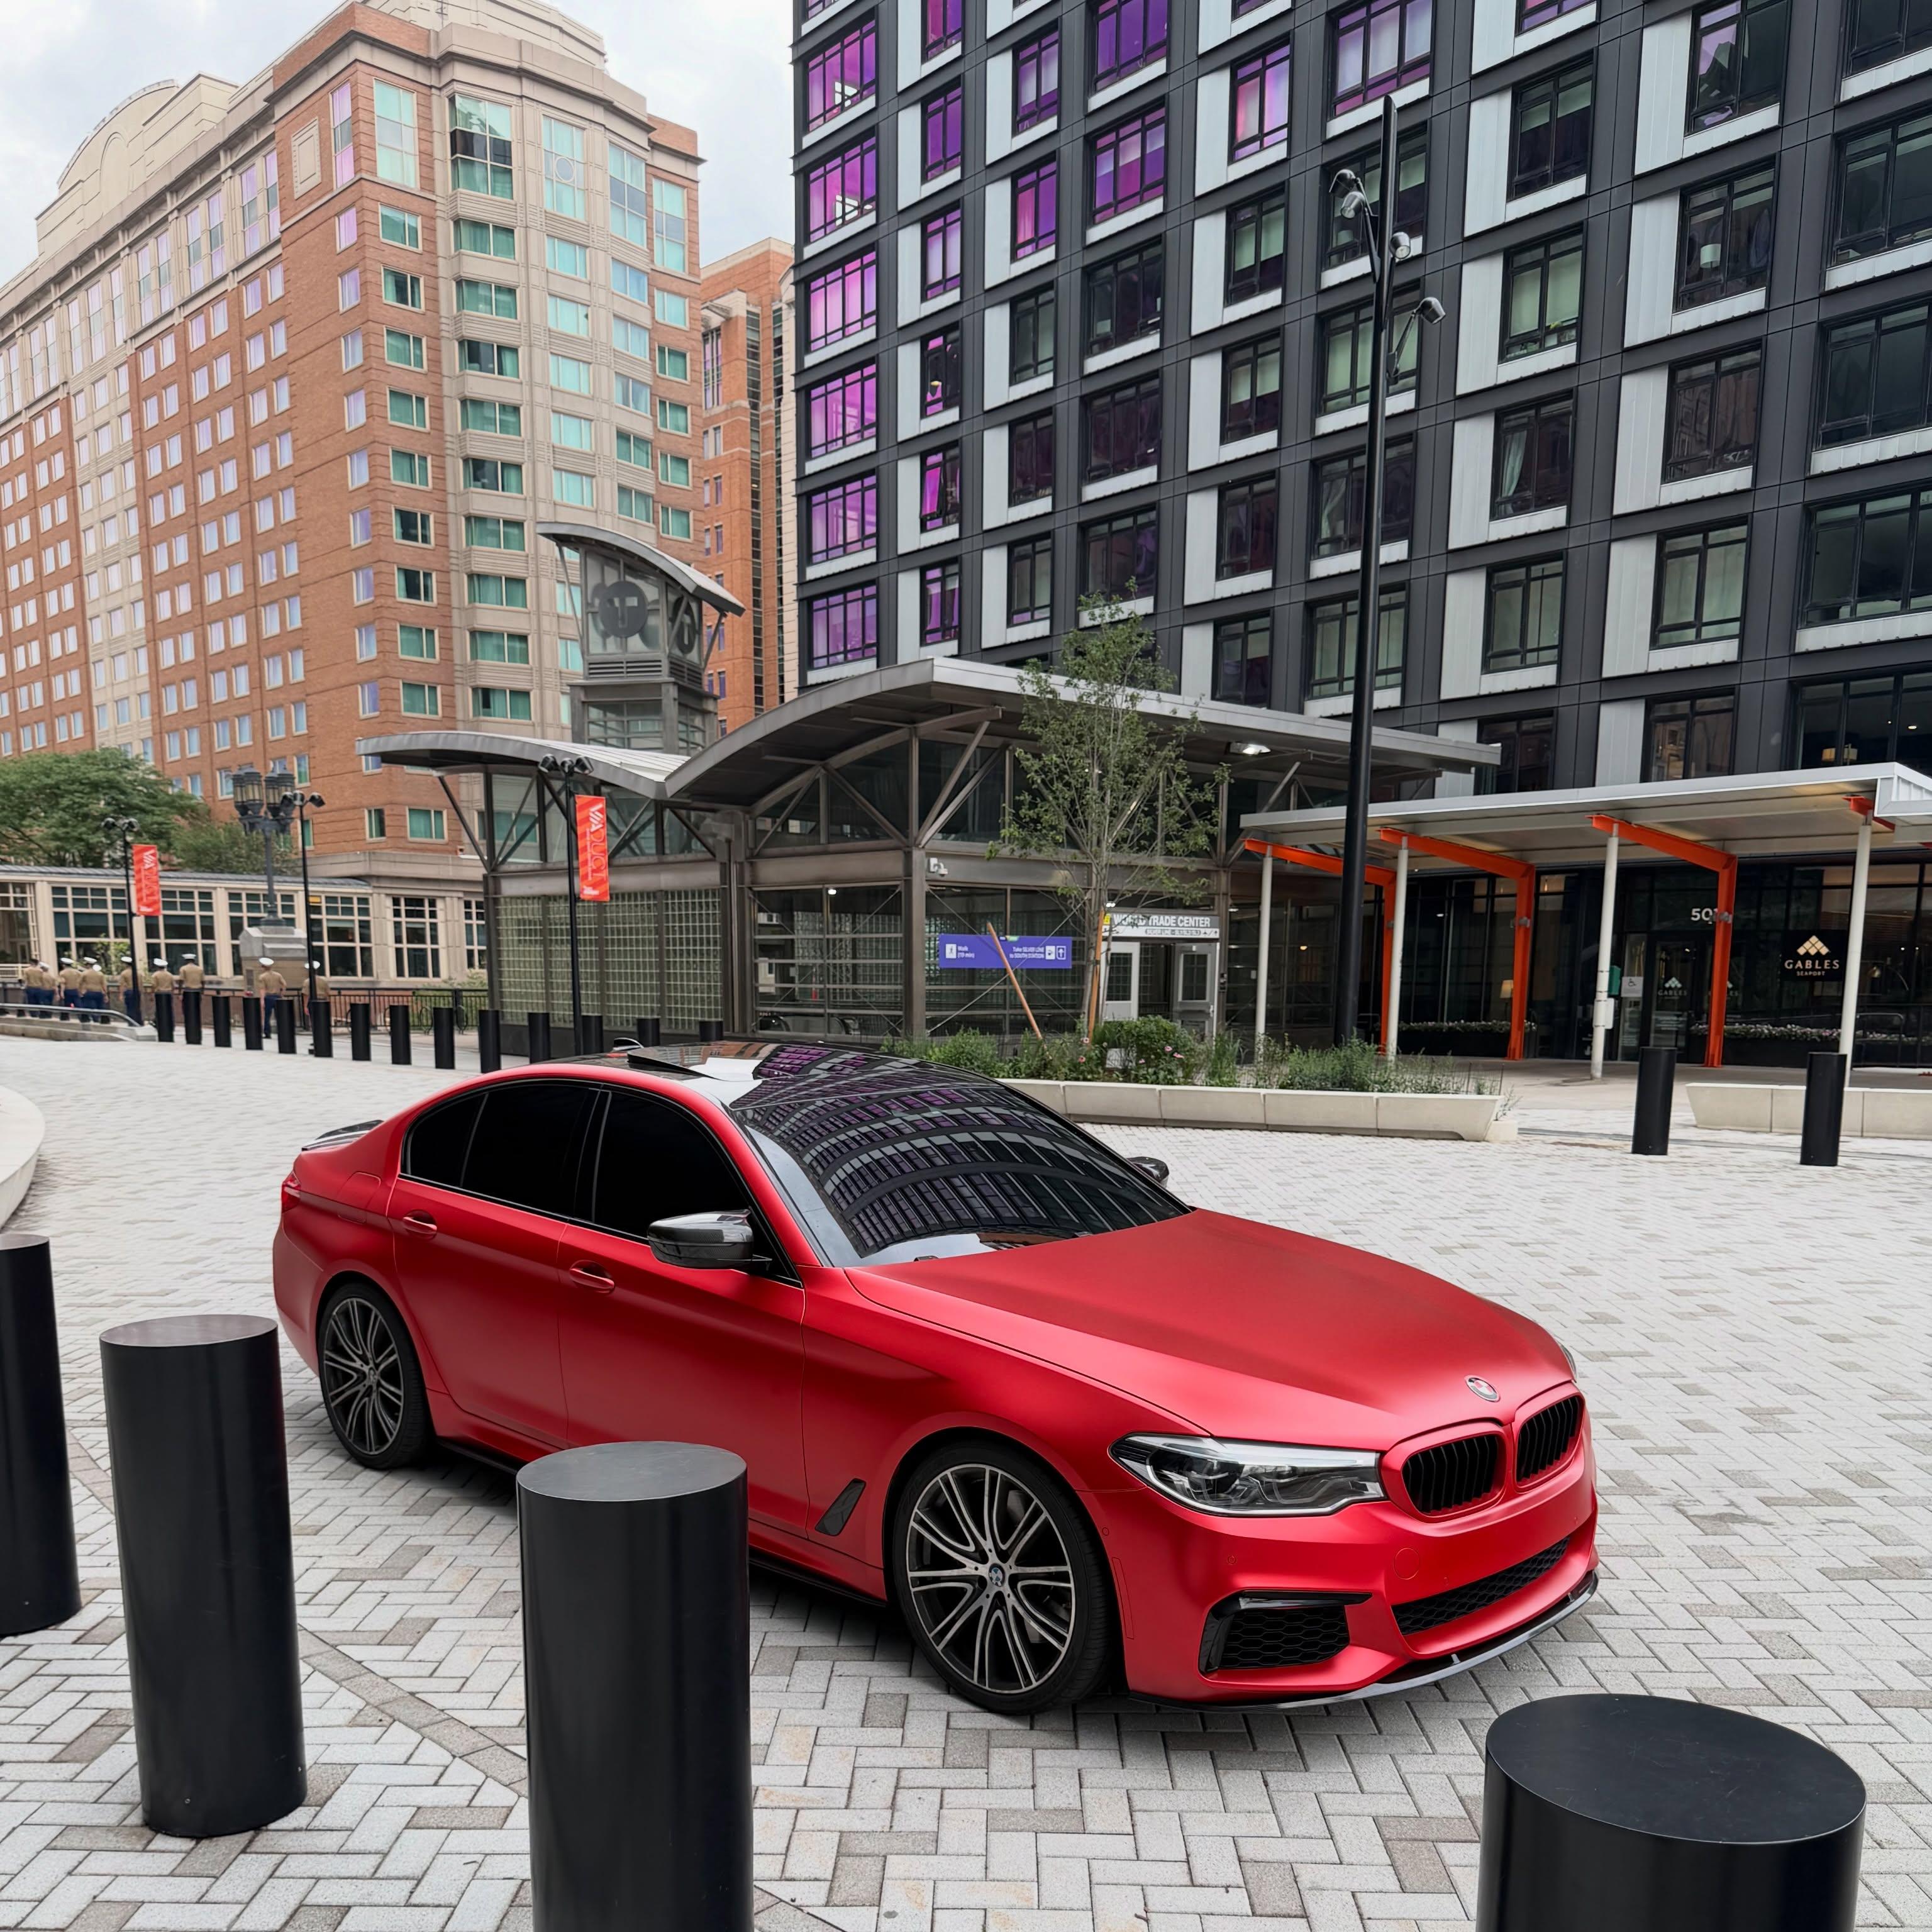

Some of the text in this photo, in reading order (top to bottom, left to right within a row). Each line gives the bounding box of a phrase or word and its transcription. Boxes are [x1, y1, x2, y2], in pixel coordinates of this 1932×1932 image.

[589, 803, 607, 881] VIADUCT
[1149, 915, 1176, 926] TRADE
[1178, 916, 1211, 927] CENTER
[1784, 960, 1840, 969] GABLES
